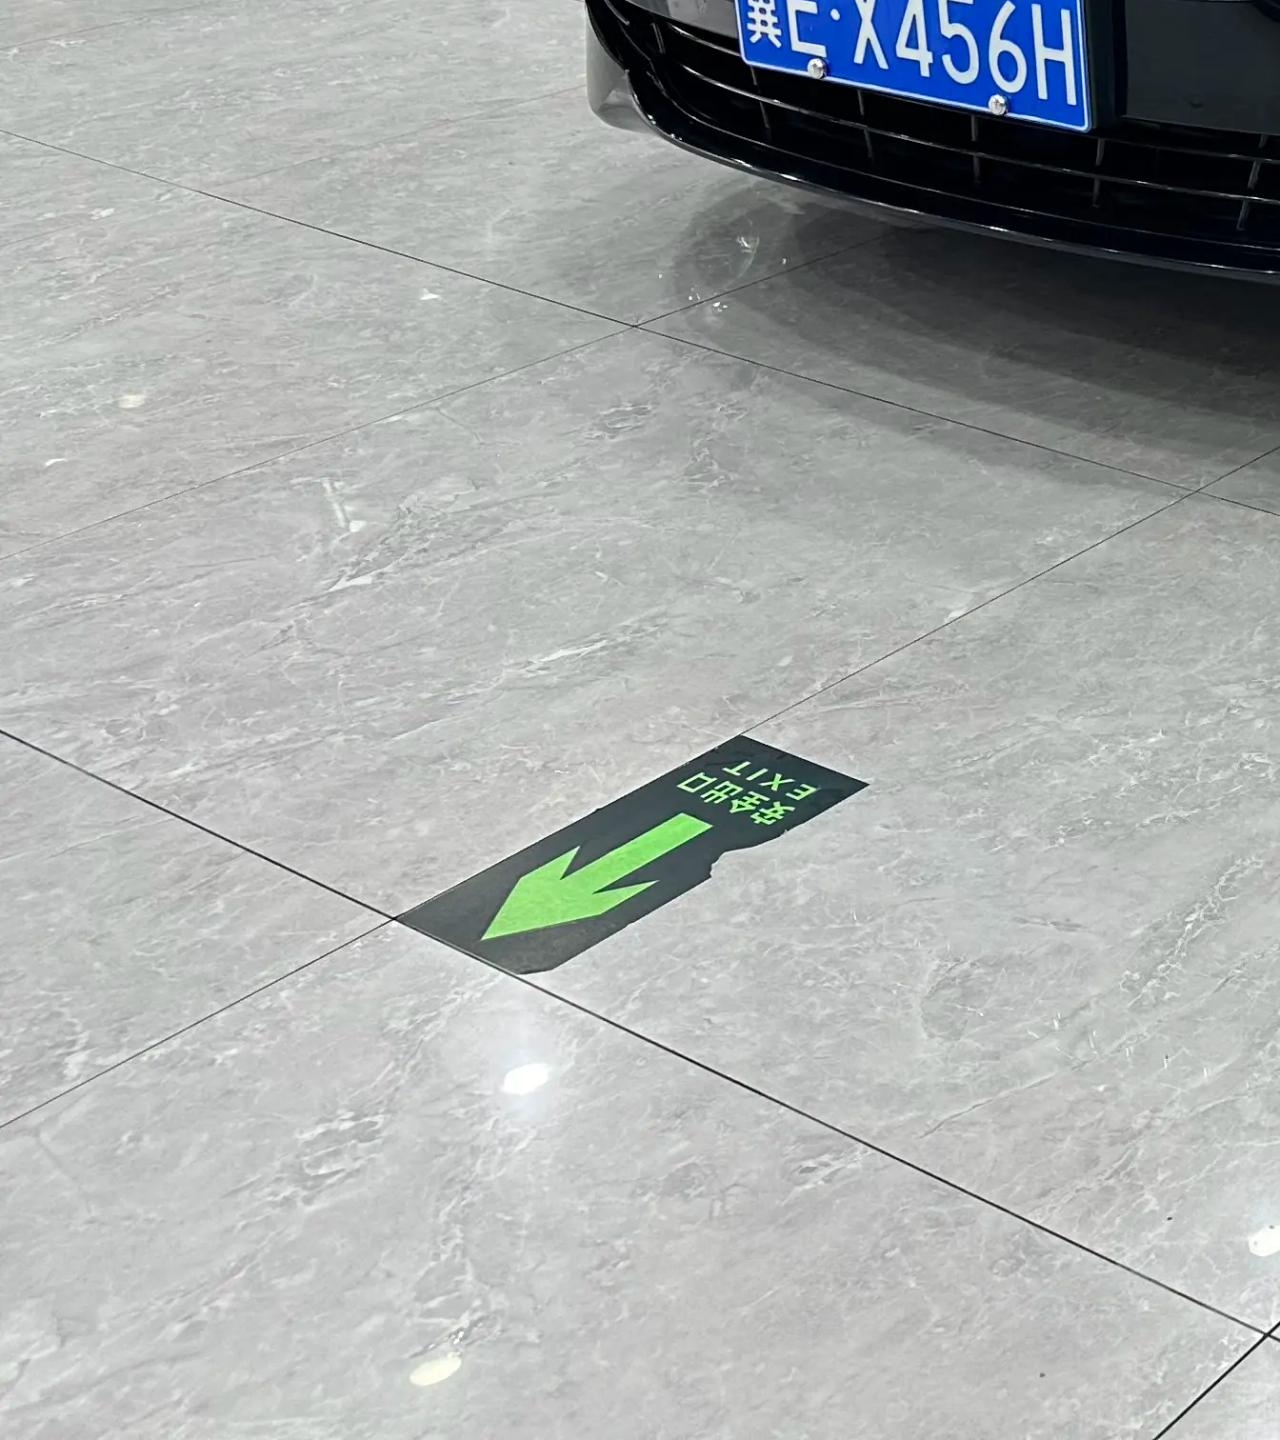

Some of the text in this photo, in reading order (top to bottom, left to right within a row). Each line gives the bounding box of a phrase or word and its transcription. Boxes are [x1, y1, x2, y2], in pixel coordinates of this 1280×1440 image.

[676, 771, 796, 825] 安全出口
[722, 760, 818, 801] EXIT
